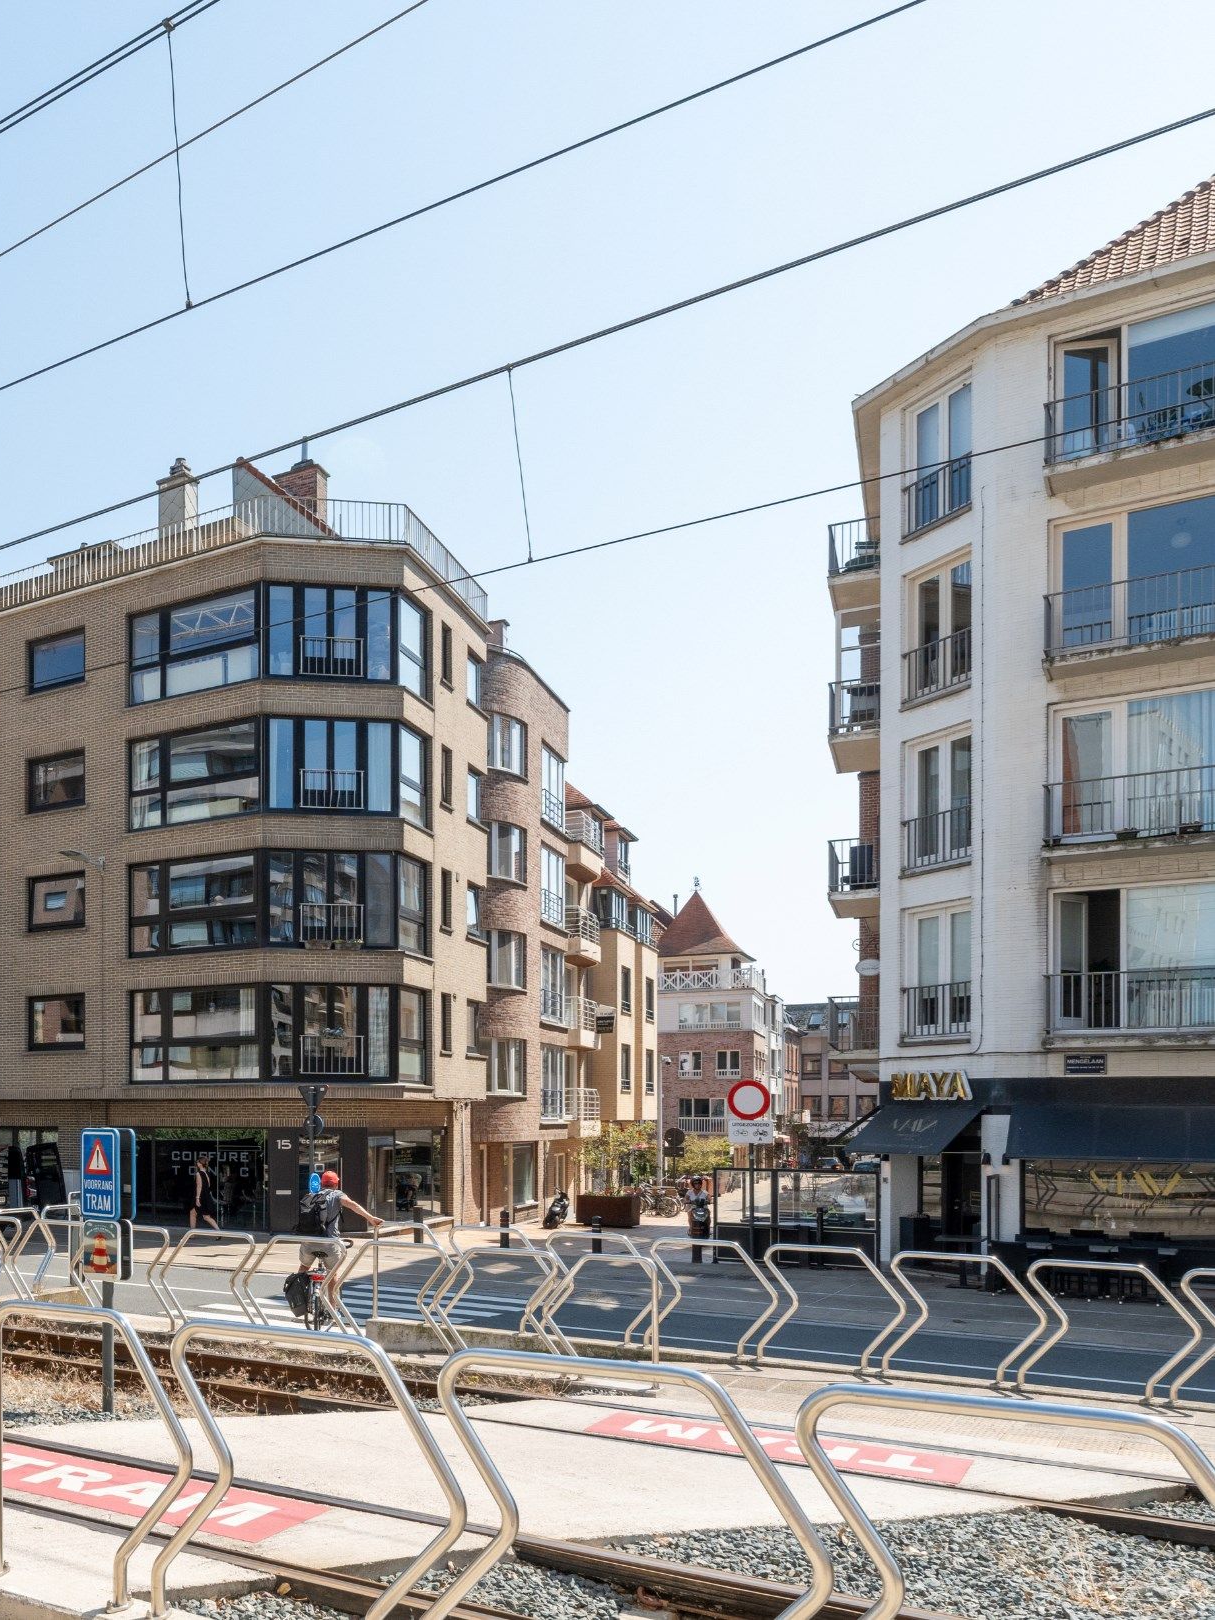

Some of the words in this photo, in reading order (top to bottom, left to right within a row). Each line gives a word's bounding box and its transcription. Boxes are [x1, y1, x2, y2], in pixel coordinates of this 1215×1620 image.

[891, 1071, 972, 1100] MAYA
[276, 1139, 292, 1149] 15
[83, 1178, 113, 1191] VOORRANG
[85, 1193, 112, 1211] TRAM
